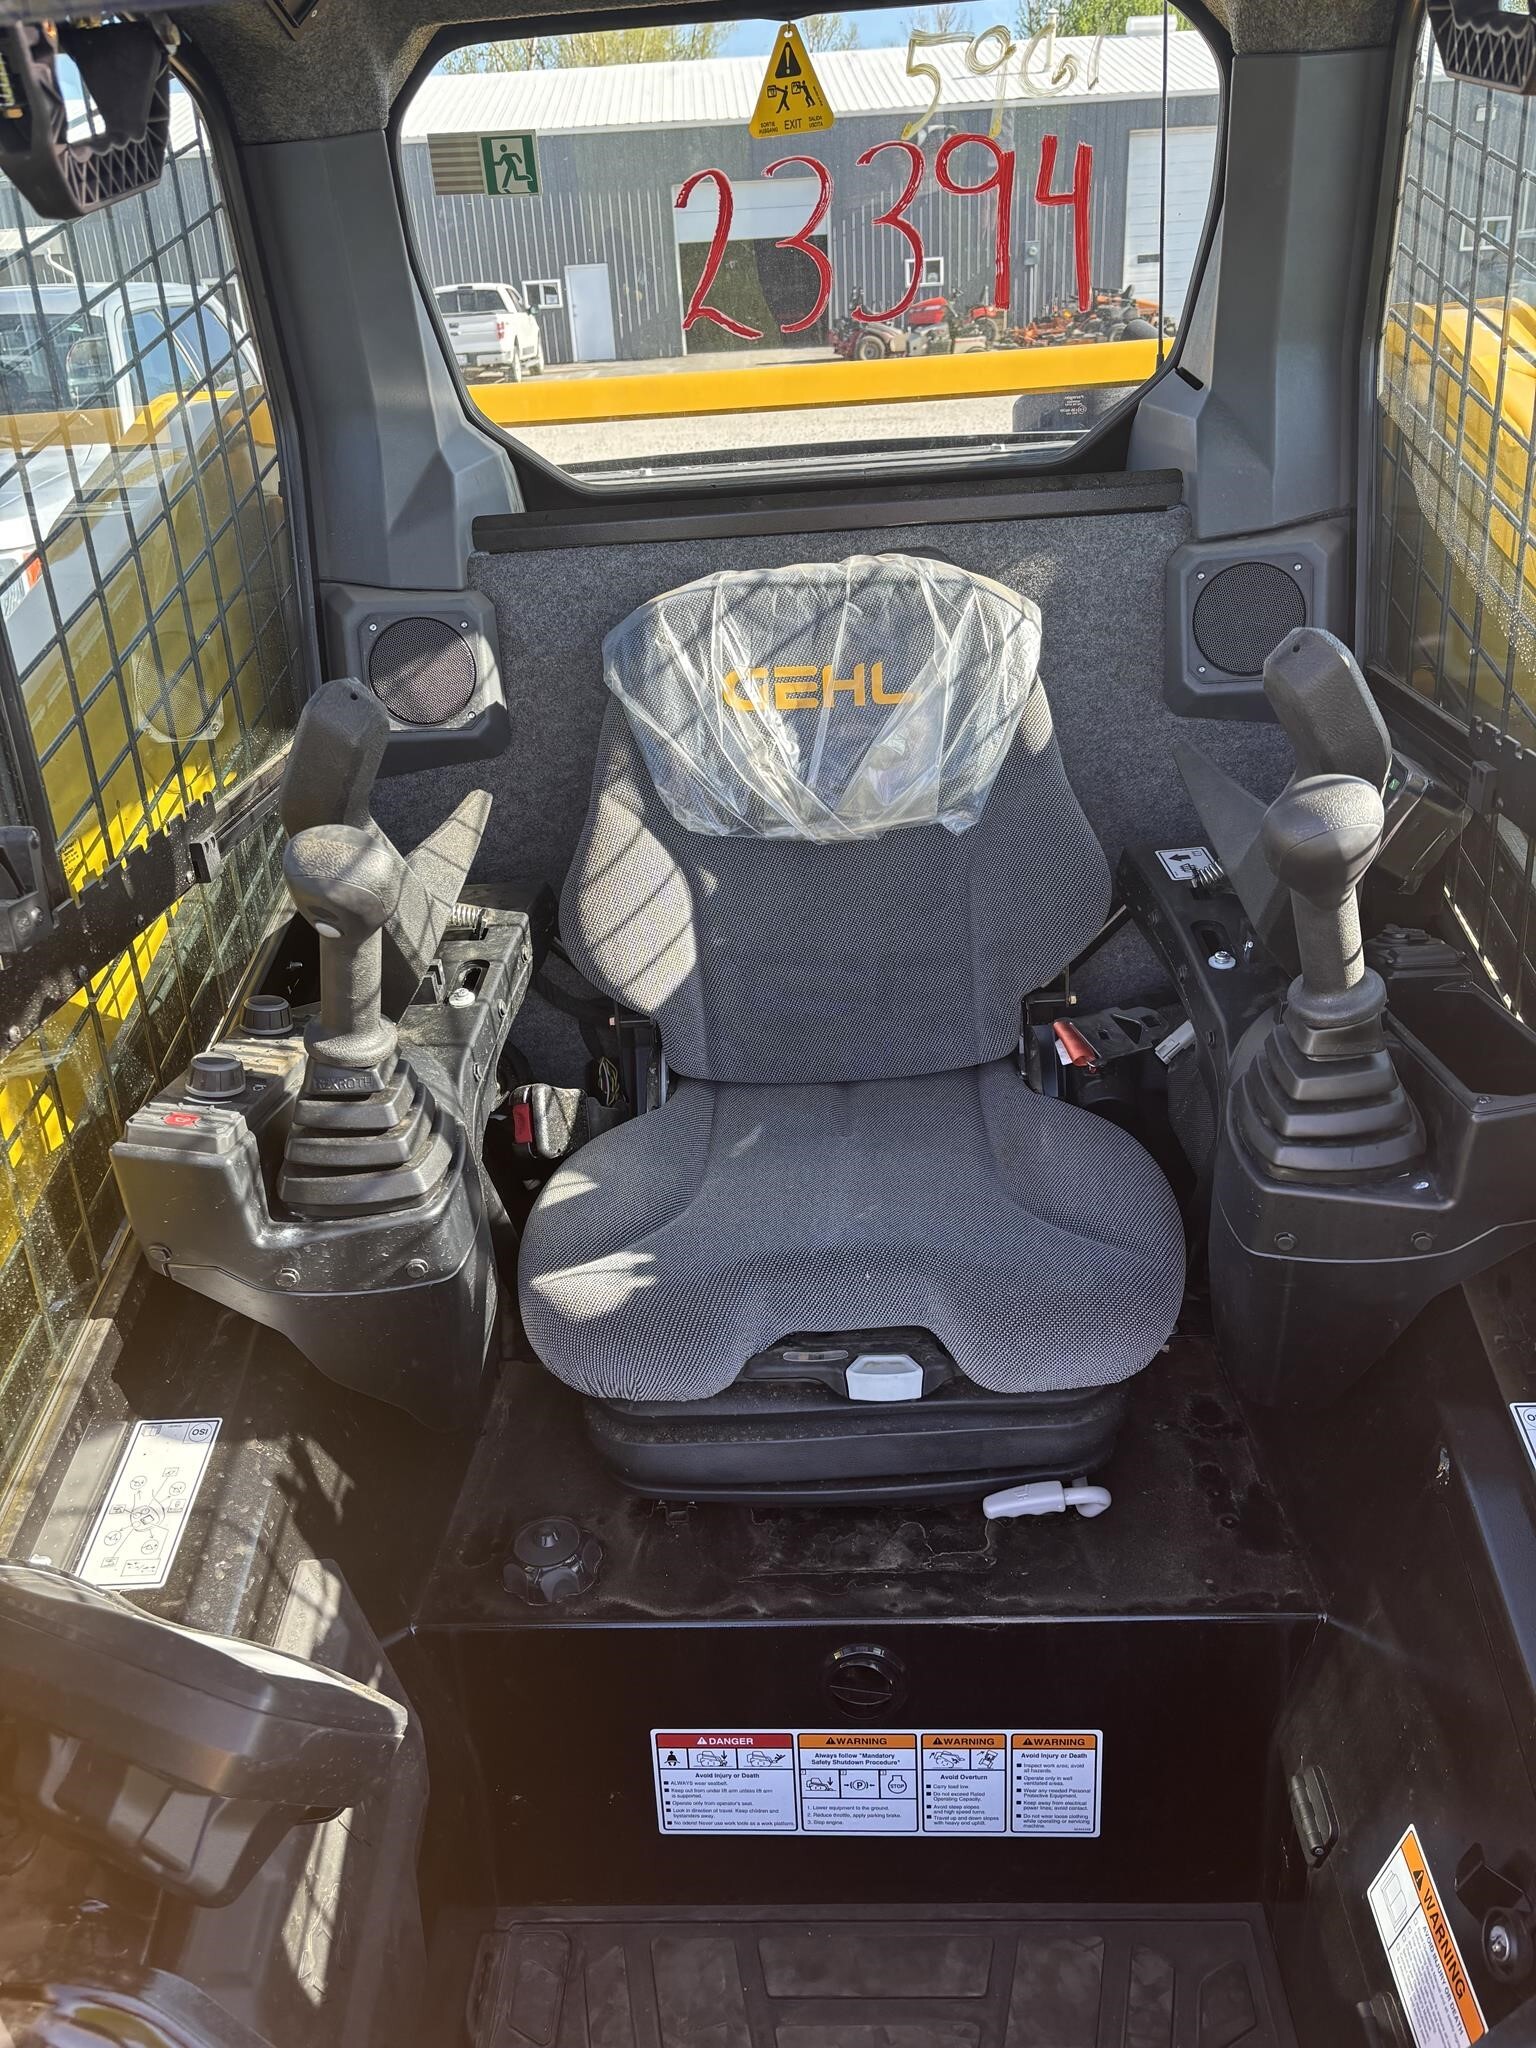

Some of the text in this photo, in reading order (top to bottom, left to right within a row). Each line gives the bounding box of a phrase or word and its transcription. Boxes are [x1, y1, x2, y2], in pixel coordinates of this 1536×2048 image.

[784, 119, 802, 130] EXIT
[723, 661, 919, 712] GEHL
[1422, 1926, 1464, 2035] AVOID INJURY OR DEATH
[1424, 1888, 1466, 2000] WARNING
